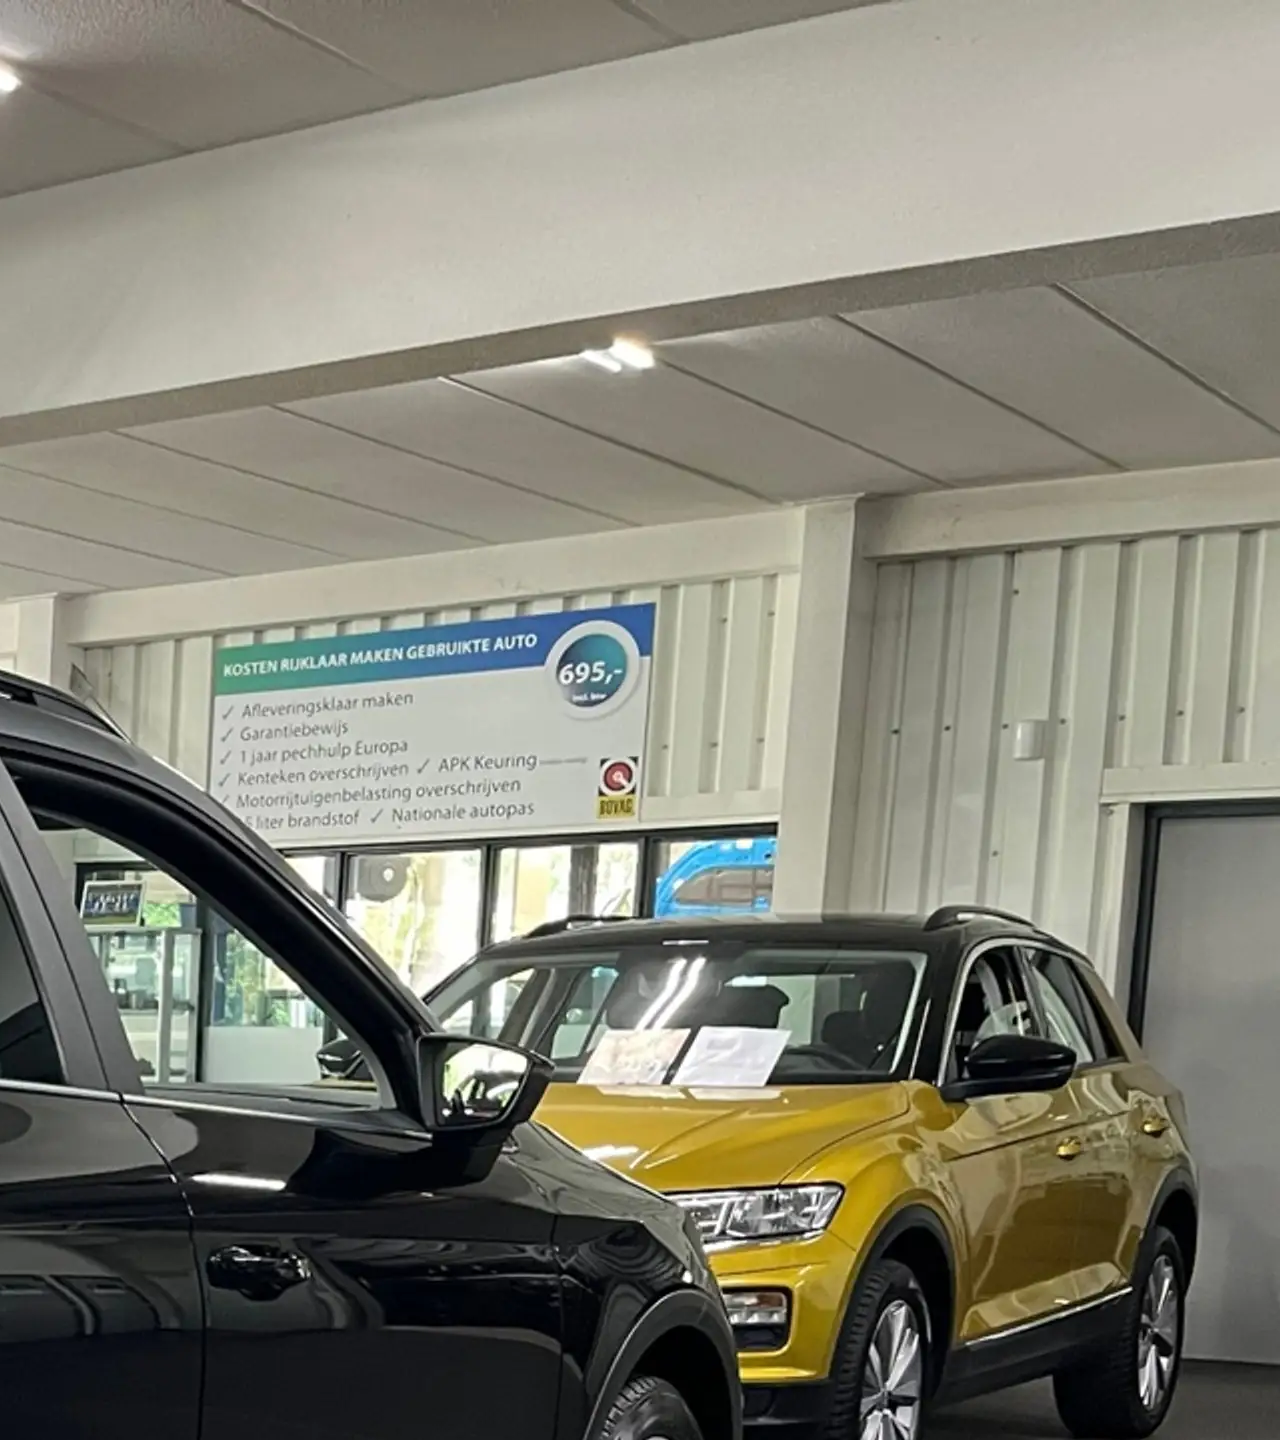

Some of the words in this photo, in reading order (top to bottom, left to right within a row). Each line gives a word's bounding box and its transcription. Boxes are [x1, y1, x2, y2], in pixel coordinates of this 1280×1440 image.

[222, 660, 278, 677] KOSTEN
[280, 653, 348, 672] RIJKLAAR
[349, 646, 403, 664] MAKEN
[406, 637, 491, 660] GEBRUIKTE
[492, 633, 538, 652] AUTO
[559, 660, 624, 685] 695,-
[241, 697, 358, 718] Afleveringsklaar
[361, 693, 414, 708] maken
[240, 721, 349, 742] Garantiebewijs
[240, 751, 246, 764] 1
[249, 749, 278, 767] jaar
[281, 743, 352, 764] pechhulp
[354, 740, 408, 757] Europa
[237, 770, 306, 787] Kenteken
[308, 762, 410, 781] overschrijven
[437, 755, 472, 773] APK
[473, 753, 538, 771] Keuring
[235, 786, 412, 809] Motorrijtuigenbelasting
[415, 778, 522, 797] overschrijven
[255, 814, 285, 830] liter
[287, 809, 360, 829] brandstof
[391, 804, 468, 823] Nationale
[469, 801, 535, 820] autopas
